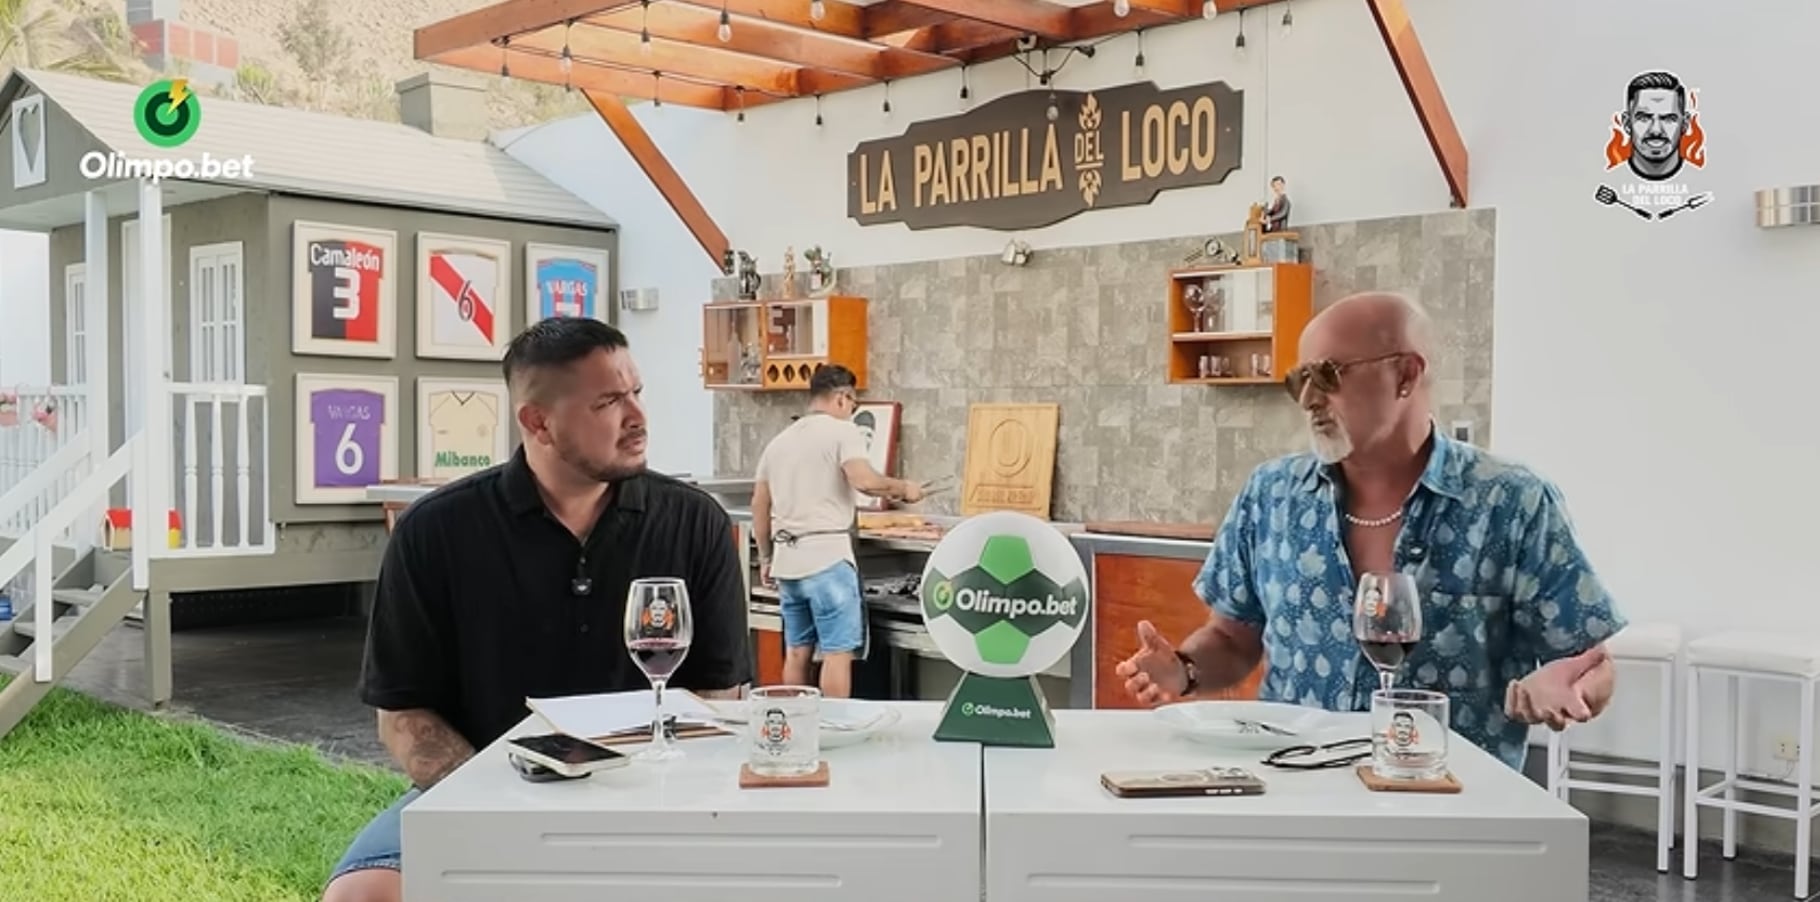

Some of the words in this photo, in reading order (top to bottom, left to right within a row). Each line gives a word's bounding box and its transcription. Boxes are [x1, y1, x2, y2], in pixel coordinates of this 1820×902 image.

[859, 148, 898, 215] LA
[912, 122, 1064, 208] PARRILLA
[1073, 129, 1105, 164] DEL
[1121, 95, 1217, 183] LOCO
[310, 242, 381, 272] Camaleón
[332, 266, 361, 320] 3
[457, 280, 474, 322] 6
[335, 422, 365, 475] 6
[434, 451, 491, 468] Mibanco
[955, 587, 1078, 620] Olimpo.bet
[974, 703, 1032, 719] Olimpo.bet
